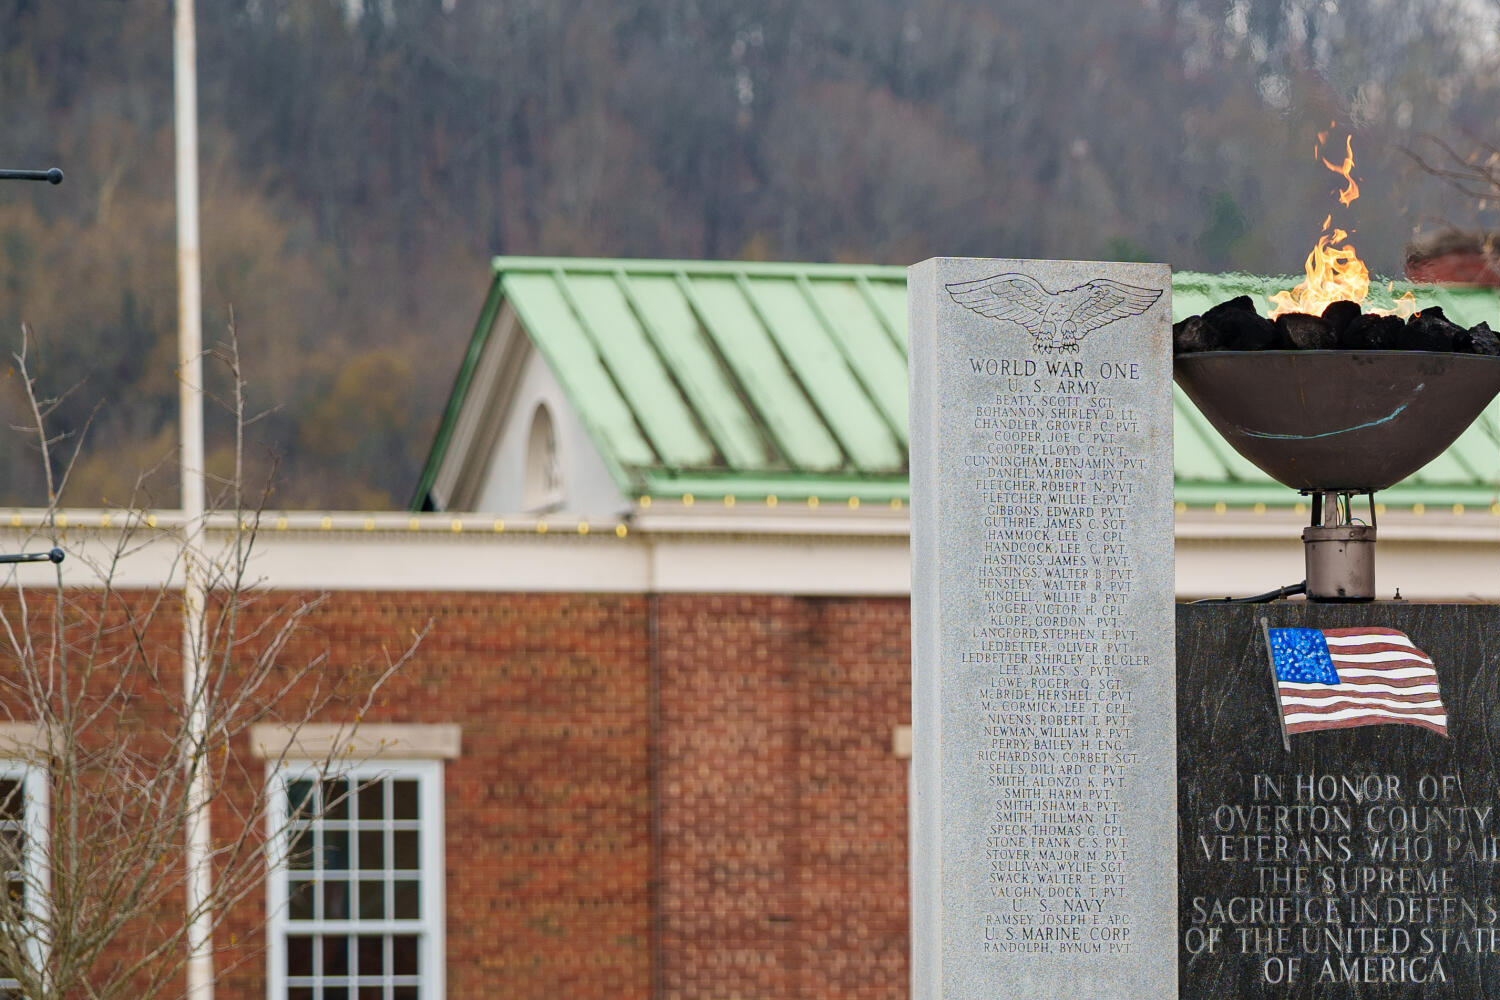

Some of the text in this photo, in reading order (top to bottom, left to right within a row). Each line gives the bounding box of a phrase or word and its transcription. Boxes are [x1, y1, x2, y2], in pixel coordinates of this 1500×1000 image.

[970, 358, 1139, 380] WORLD WAR ONE
[1057, 381, 1100, 395] ARMY
[1044, 518, 1082, 529] JAMES
[1027, 665, 1065, 676] JAMES
[1253, 774, 1455, 802] IN HONOR OF
[1215, 805, 1492, 833] OVERTON COUNTY
[1201, 835, 1351, 862] VETERANS
[1369, 836, 1432, 862] WHO
[1253, 866, 1454, 893] THE SUPREME
[1192, 896, 1340, 924] SACRIFICE
[1351, 898, 1377, 923] IN
[1022, 928, 1080, 940] MARINE
[1186, 928, 1222, 955] OF
[1236, 928, 1291, 953] THE
[1301, 928, 1410, 954] UNITED
[1264, 957, 1447, 984] OF AMERICA
